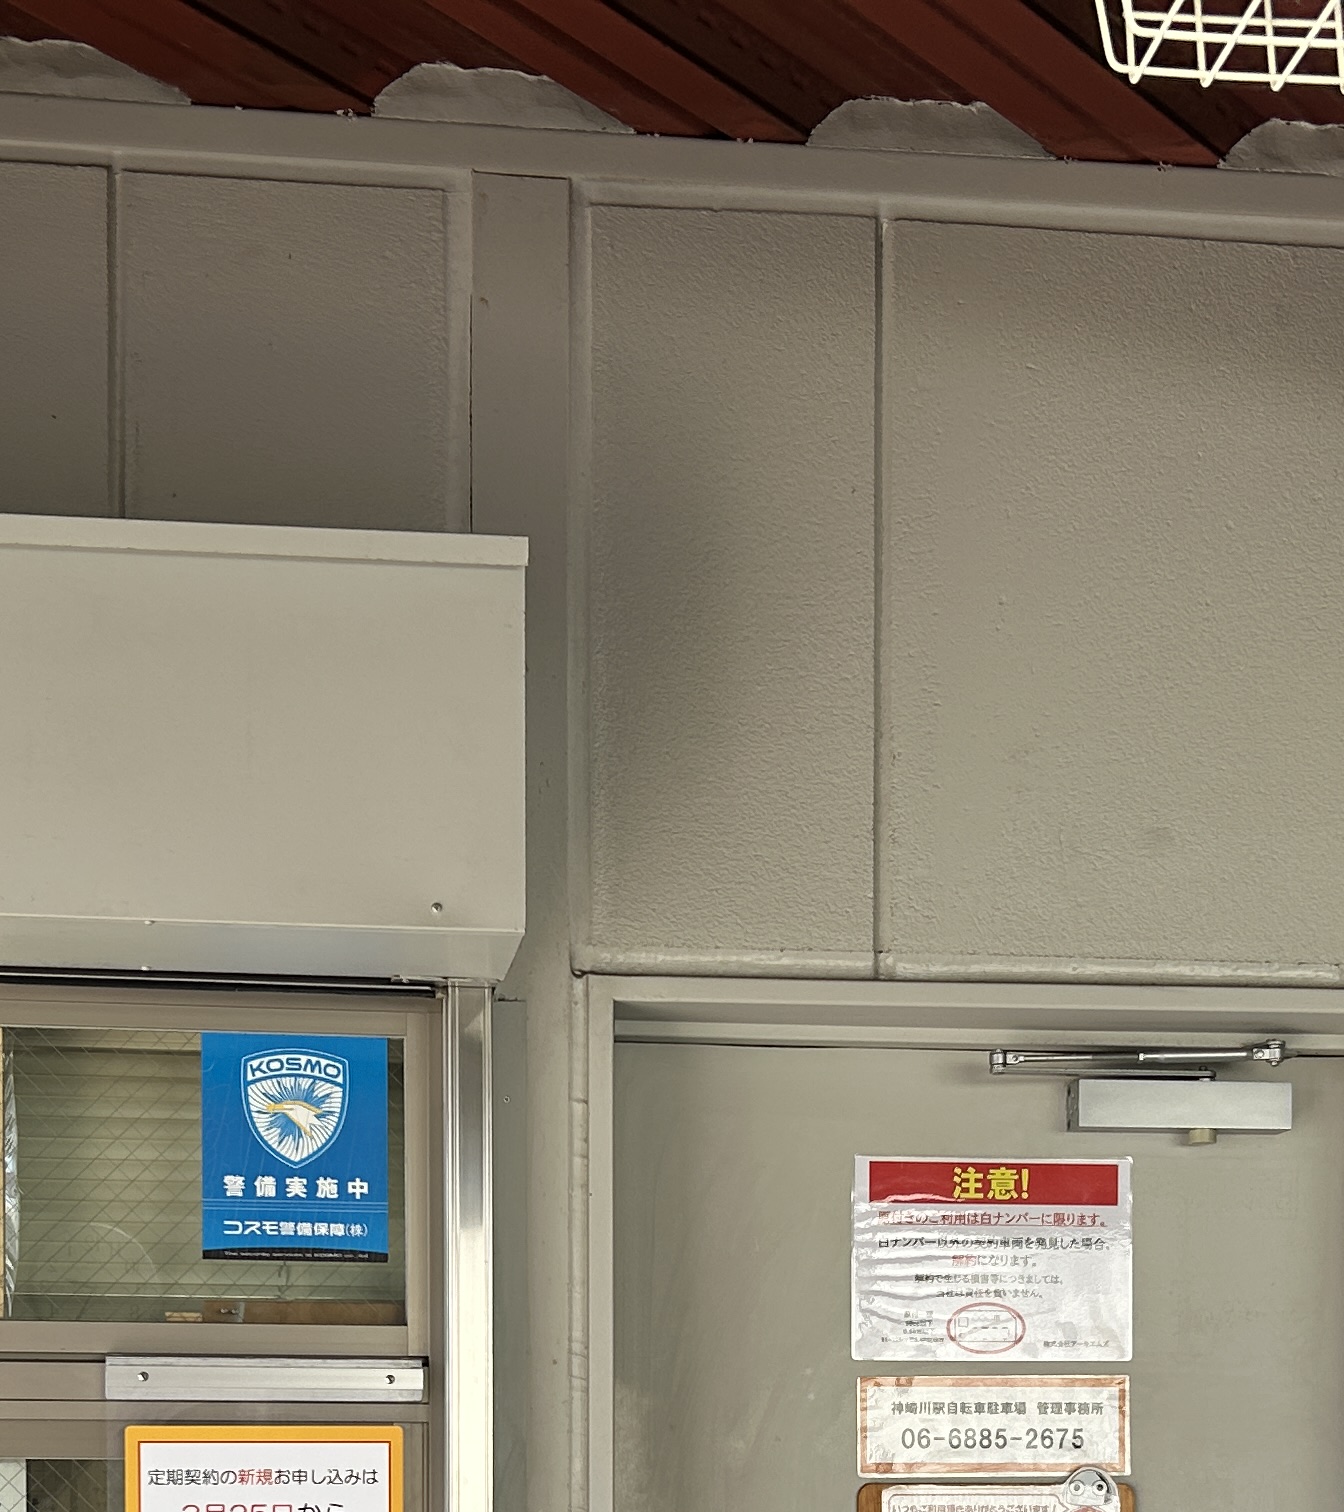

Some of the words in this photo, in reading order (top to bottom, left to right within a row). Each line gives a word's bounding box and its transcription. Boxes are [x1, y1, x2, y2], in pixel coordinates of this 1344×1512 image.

[249, 1057, 341, 1080] KOSMO
[222, 1174, 370, 1200] 警備実施中
[953, 1166, 1030, 1200] 注意!
[222, 1219, 368, 1237] コスモ警備保障(株)
[1037, 1401, 1104, 1416] 管理事務所
[901, 1427, 1085, 1450] 06-6885-2675
[147, 1467, 379, 1487] 定期契約の新規お申し込みは
